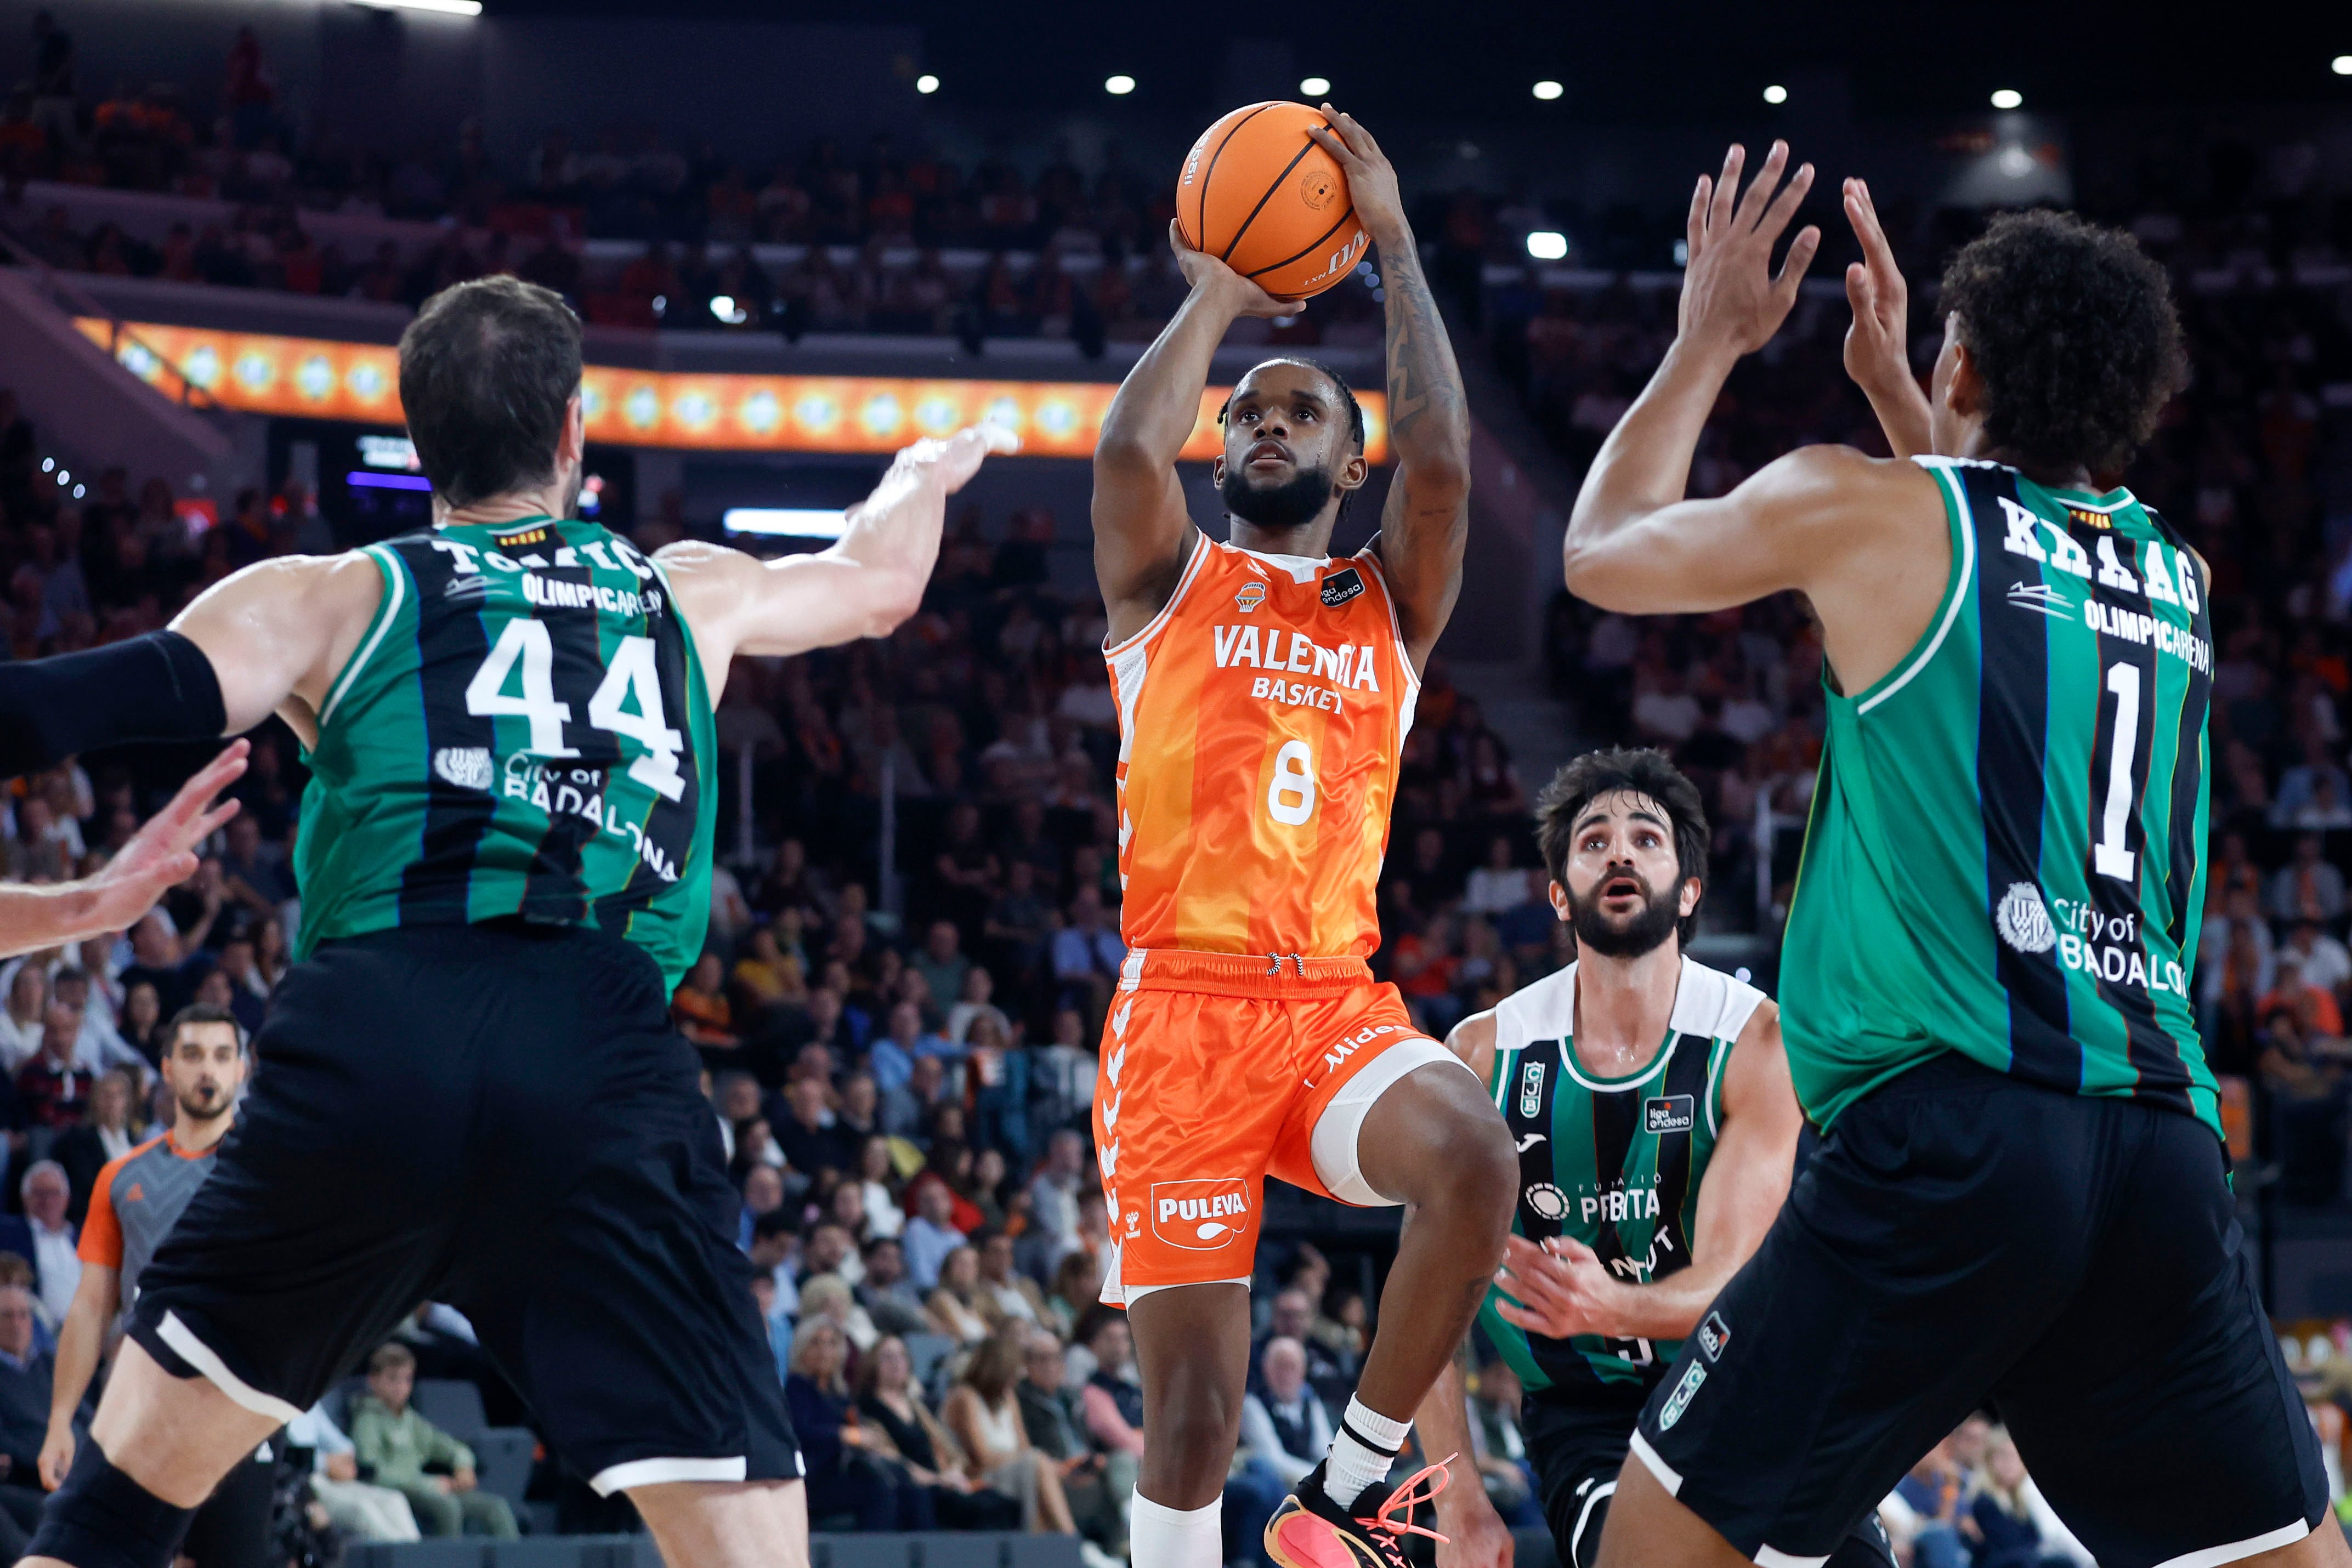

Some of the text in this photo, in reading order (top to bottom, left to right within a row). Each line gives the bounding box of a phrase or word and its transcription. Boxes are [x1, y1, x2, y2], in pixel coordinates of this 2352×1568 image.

[1322, 584, 1361, 604] endesa
[2084, 599, 2209, 675] OLIMPICARENA
[465, 617, 687, 803] 44
[1267, 740, 1316, 826] 8
[2095, 661, 2140, 882] 1
[2054, 898, 2135, 942] City of
[1650, 1108, 1669, 1120] liga
[1650, 1116, 1689, 1129] endesa
[1159, 1192, 1246, 1223] PULEVA
